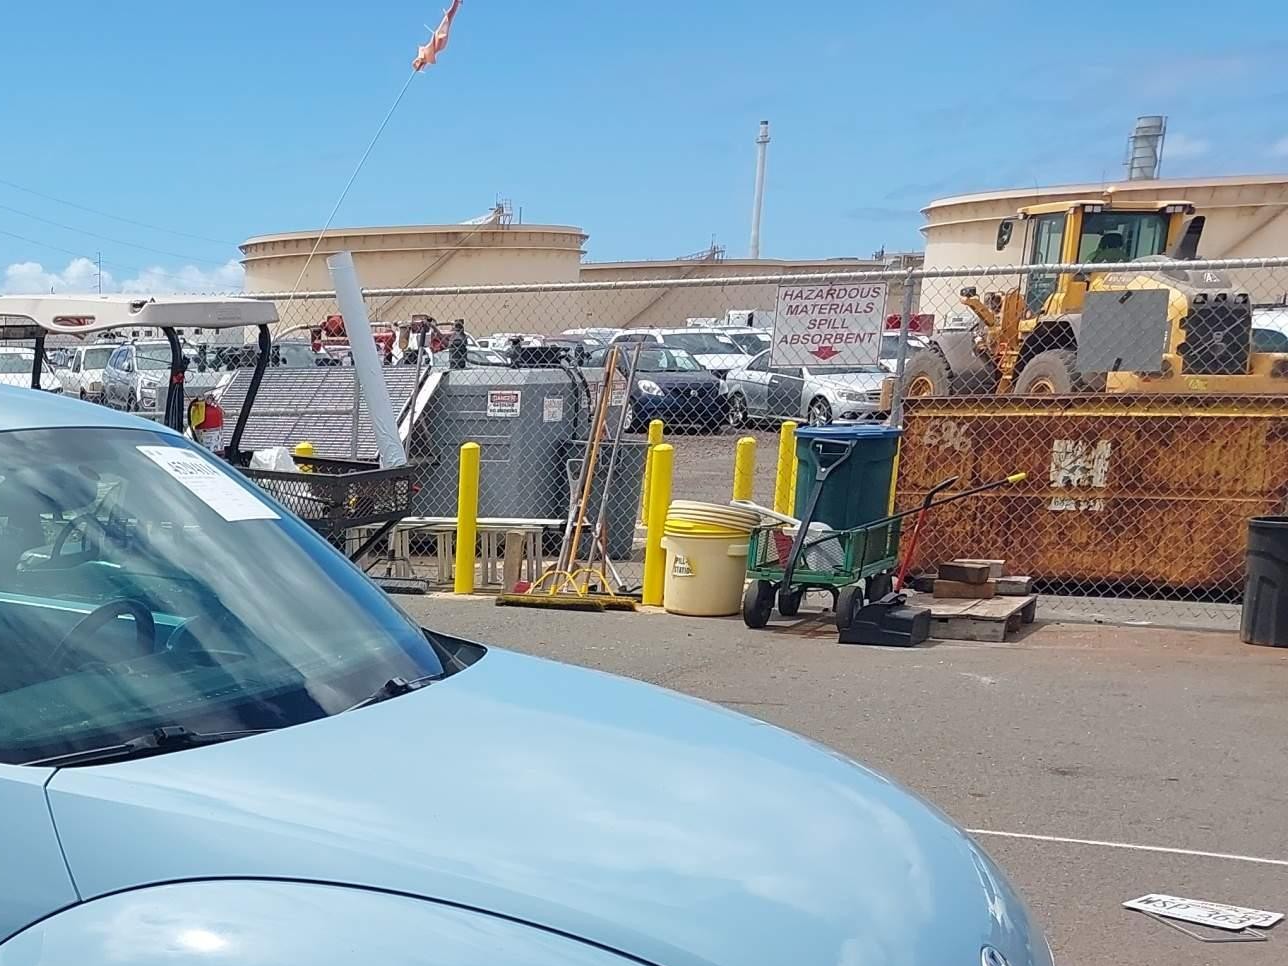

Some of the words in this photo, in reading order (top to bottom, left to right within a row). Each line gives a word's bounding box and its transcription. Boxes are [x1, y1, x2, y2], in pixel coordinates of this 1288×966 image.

[783, 286, 881, 301] HAZARDOUS
[785, 302, 875, 316] MATERIALS
[807, 318, 849, 330] SPILL
[778, 332, 877, 345] ABSORBENT
[1137, 896, 1191, 910] WSP
